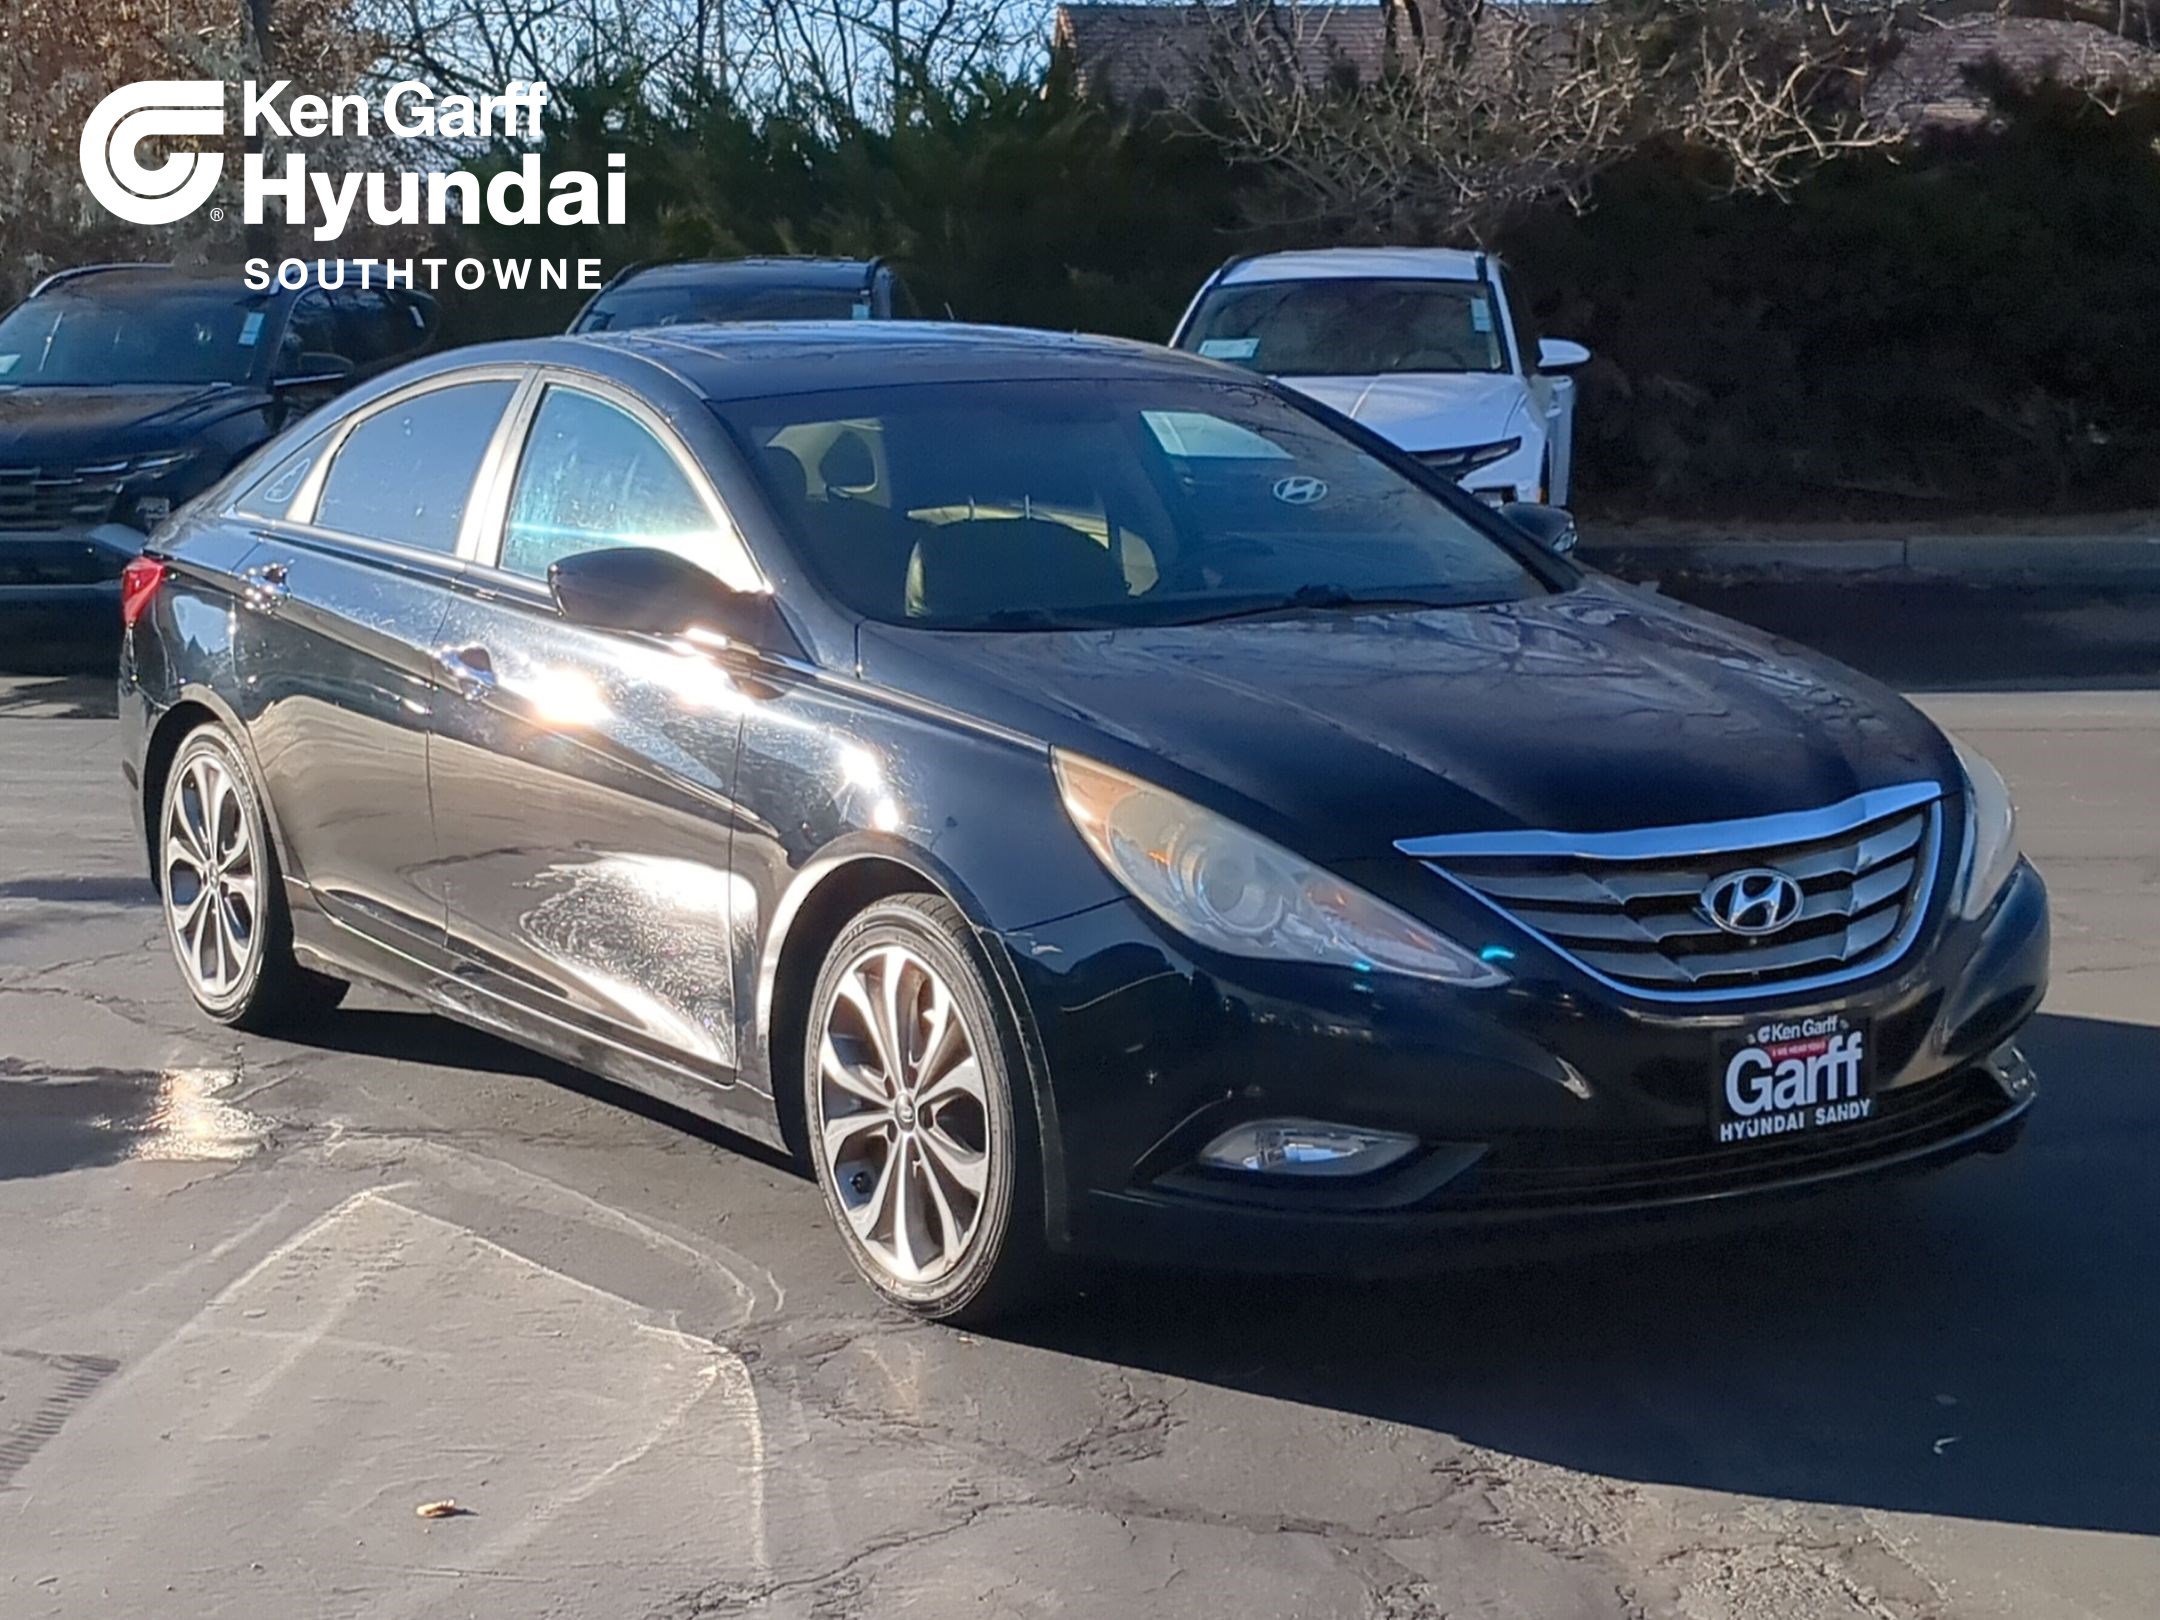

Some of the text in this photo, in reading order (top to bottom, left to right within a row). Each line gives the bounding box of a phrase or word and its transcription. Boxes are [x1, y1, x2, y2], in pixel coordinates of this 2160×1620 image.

[1771, 1015, 1838, 1042] Ken Garff
[1725, 1031, 1863, 1117] Garff
[1720, 1099, 1871, 1142] HYUNDAI SANDY
